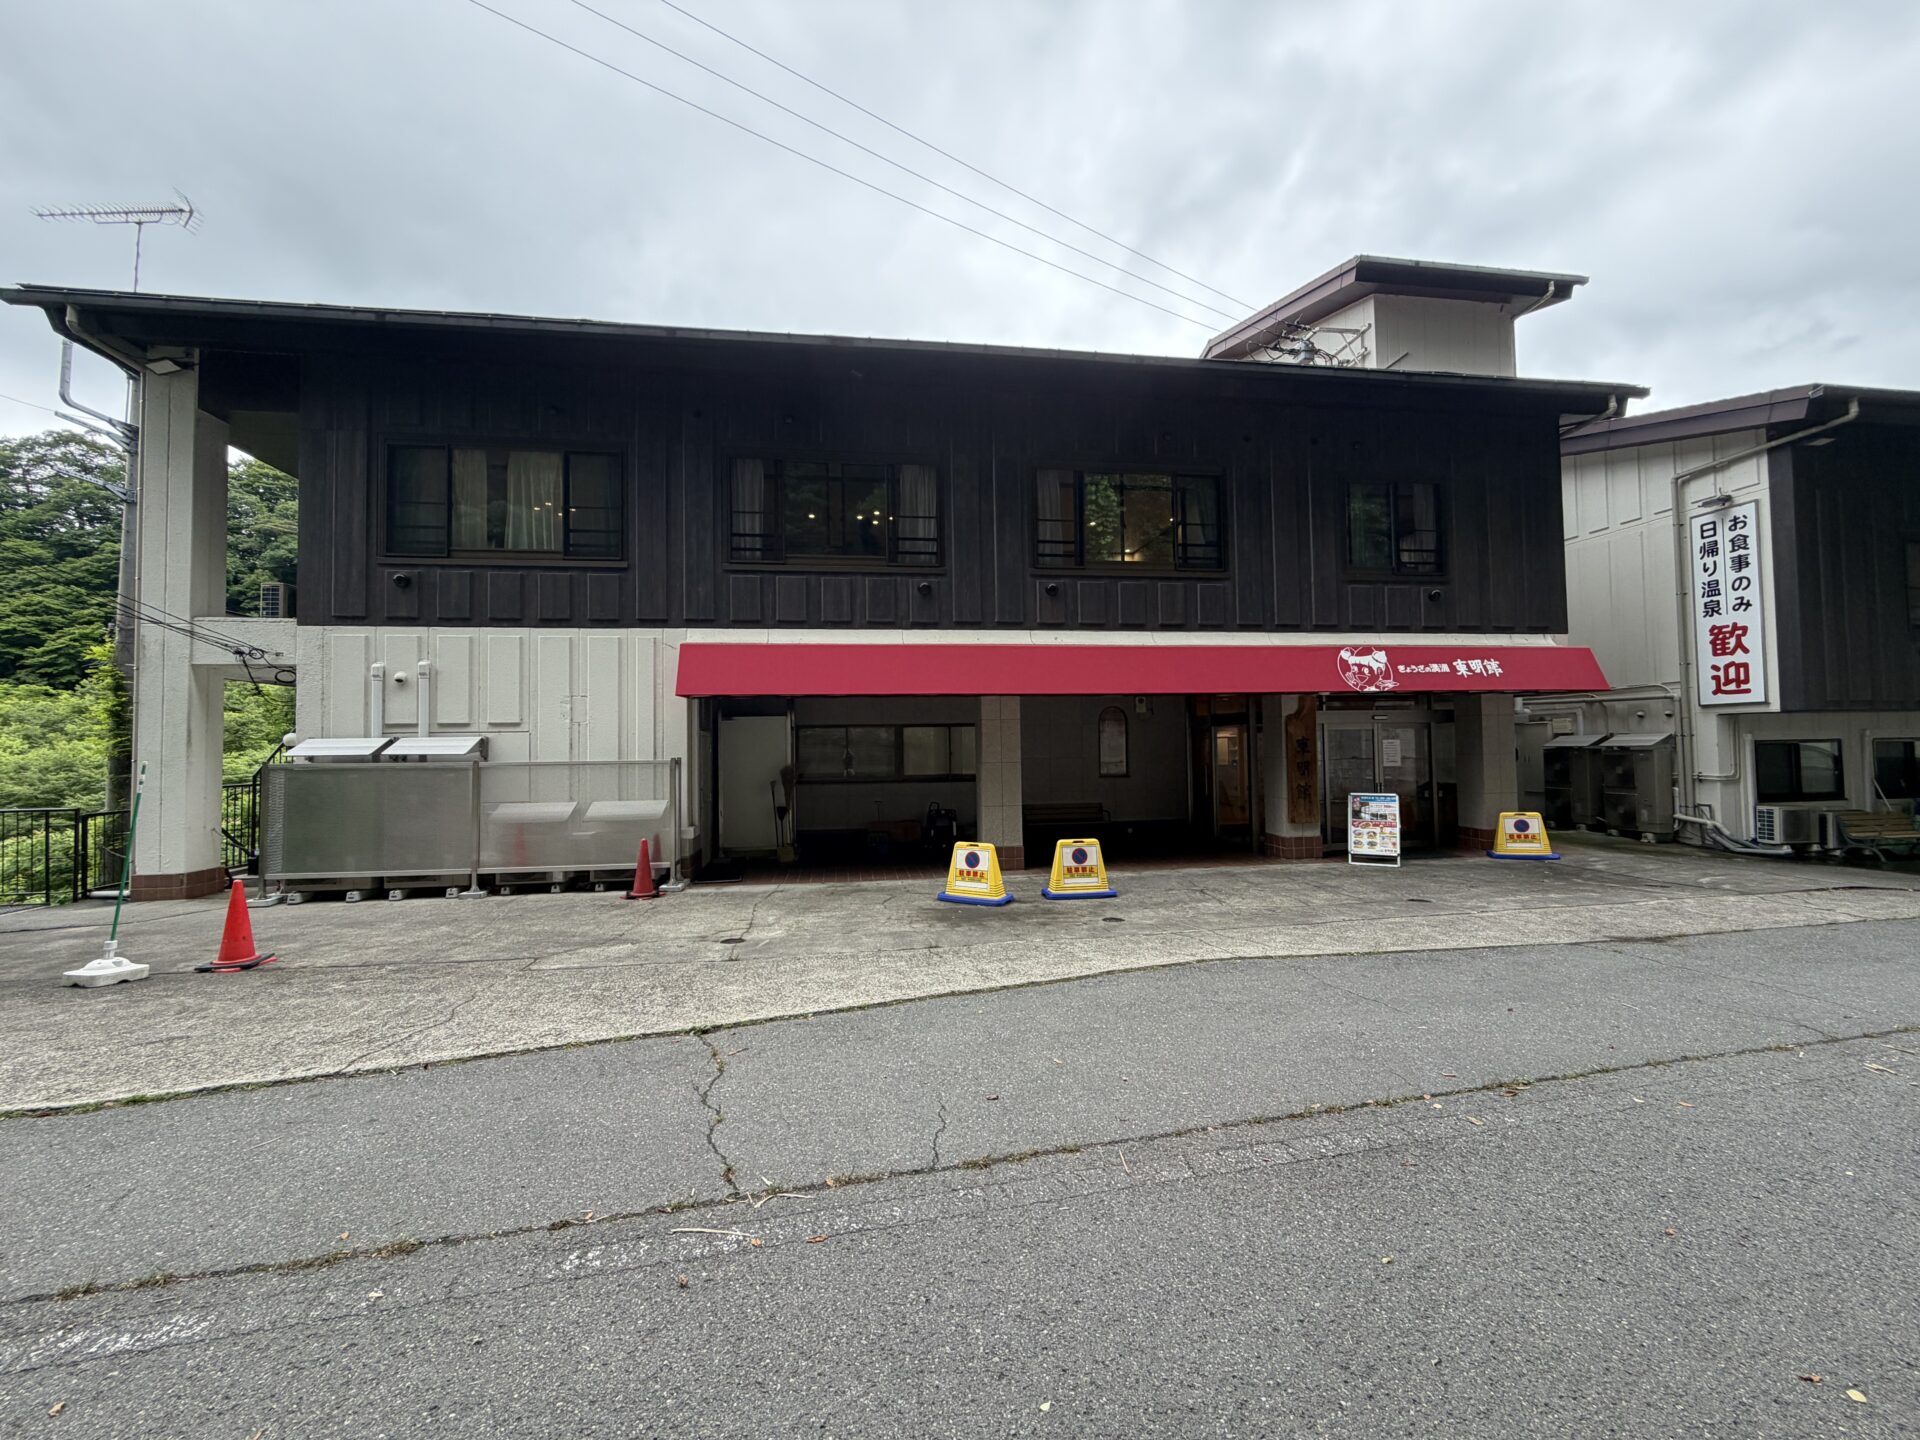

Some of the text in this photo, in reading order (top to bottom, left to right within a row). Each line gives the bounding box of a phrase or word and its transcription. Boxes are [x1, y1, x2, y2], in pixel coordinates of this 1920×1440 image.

[1699, 521, 1722, 618] 日帰り温泉
[1728, 514, 1753, 613] お食事のみ
[1708, 621, 1752, 696] 歓迎
